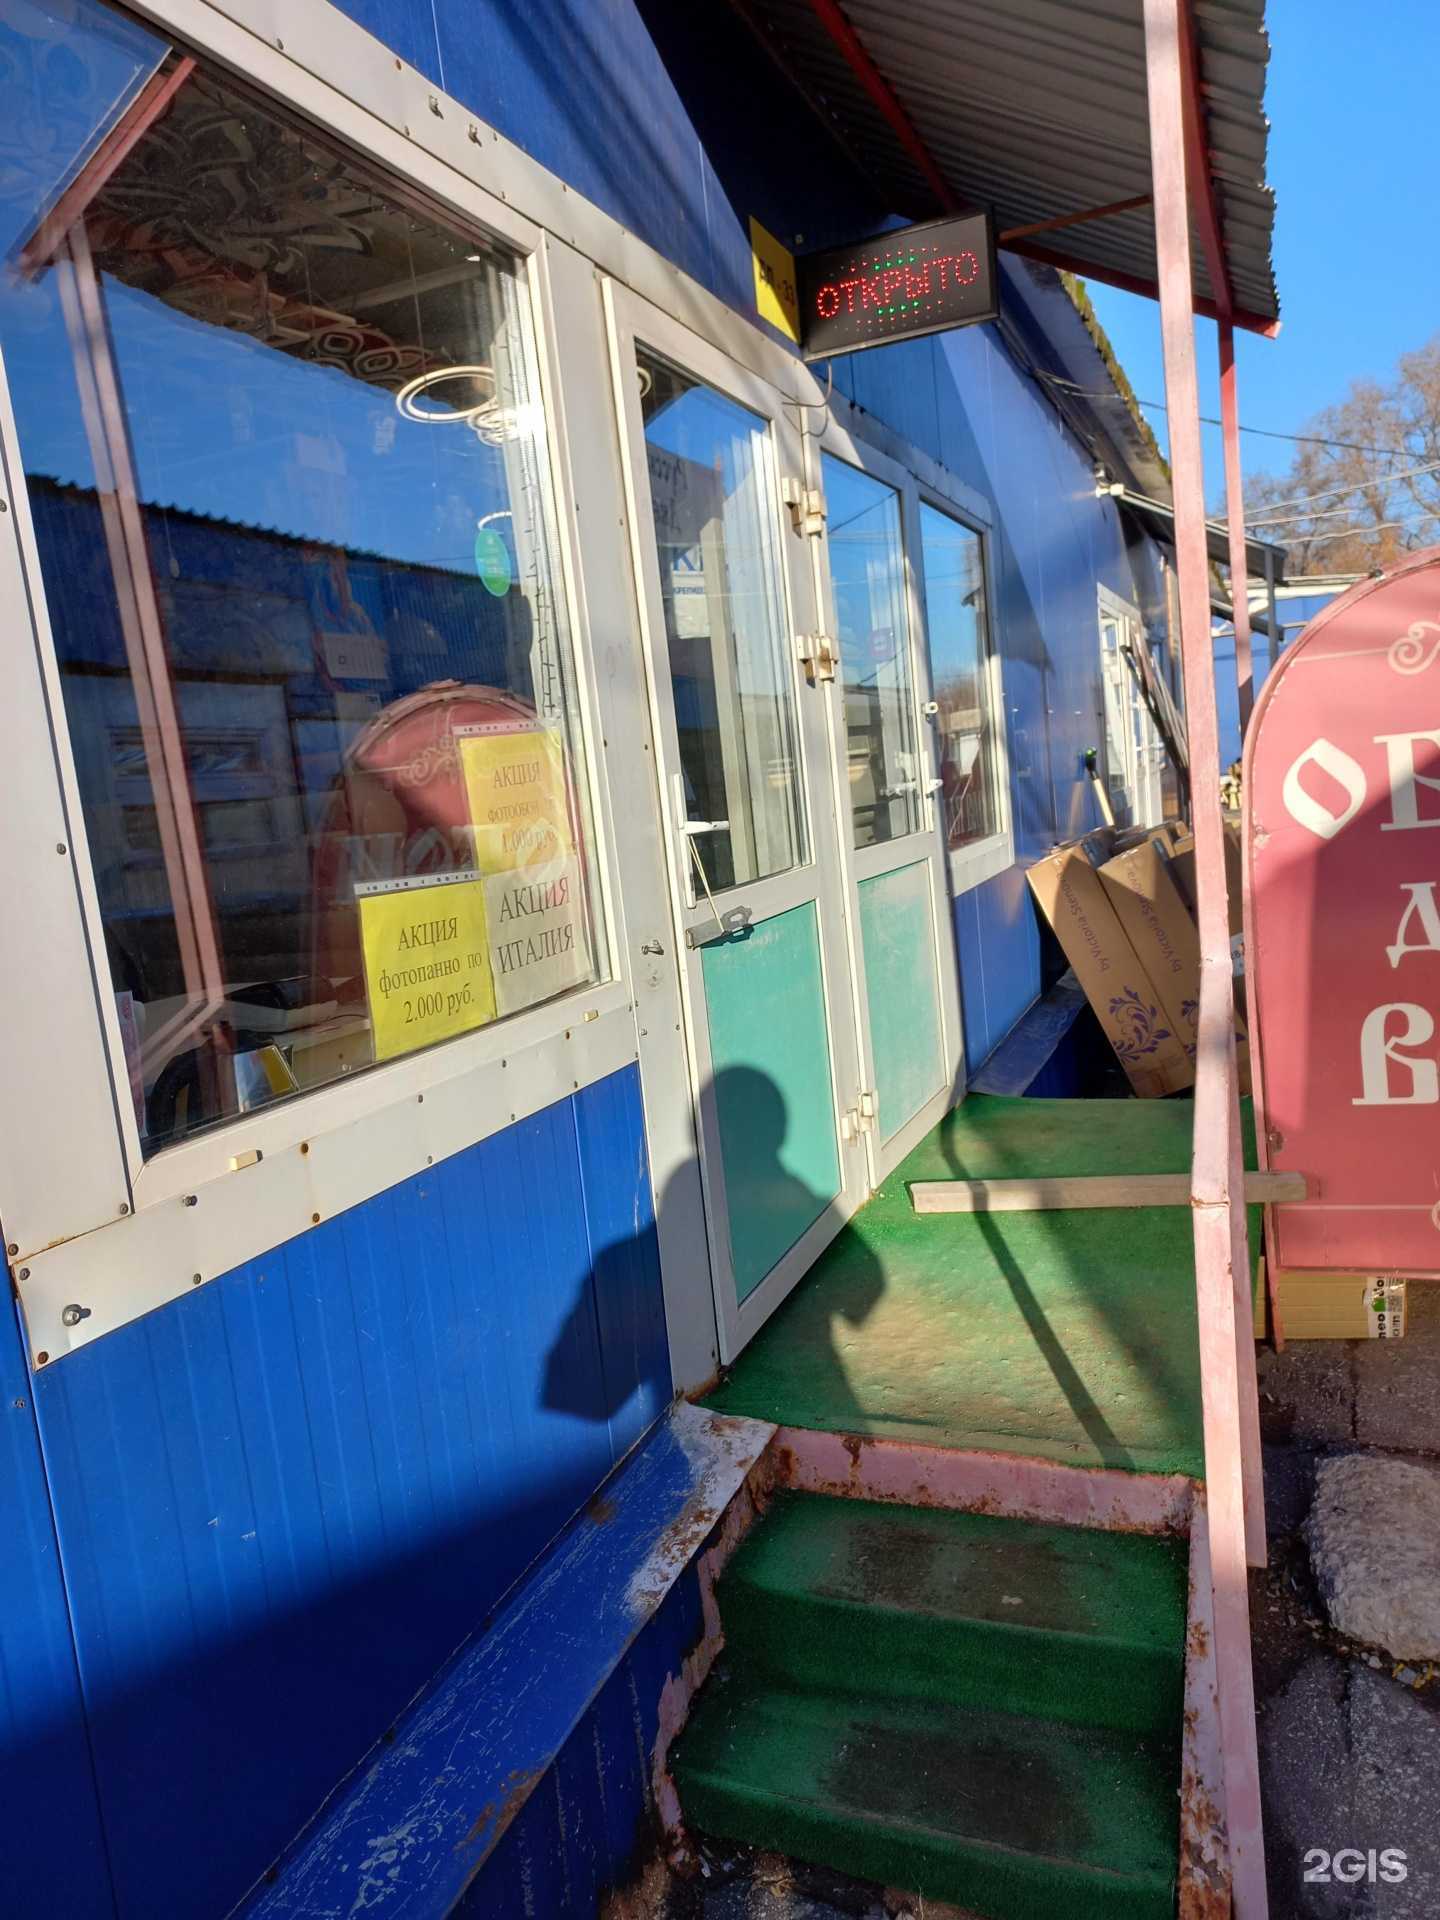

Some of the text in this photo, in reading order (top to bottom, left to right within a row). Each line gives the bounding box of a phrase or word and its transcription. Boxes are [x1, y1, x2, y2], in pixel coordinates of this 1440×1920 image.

[816, 249, 979, 318] ОТКРЫТО
[493, 761, 540, 789] АКЦИЯ
[499, 876, 571, 924] АКЦИЯ
[398, 917, 458, 951] АКЦИЯ
[497, 923, 575, 975] ИТАЛИЯ
[1078, 915, 1103, 958] Victoria
[1148, 914, 1175, 959] Victoria
[379, 952, 483, 1000] фотопанно по
[402, 982, 476, 1025] 2.000 руб.
